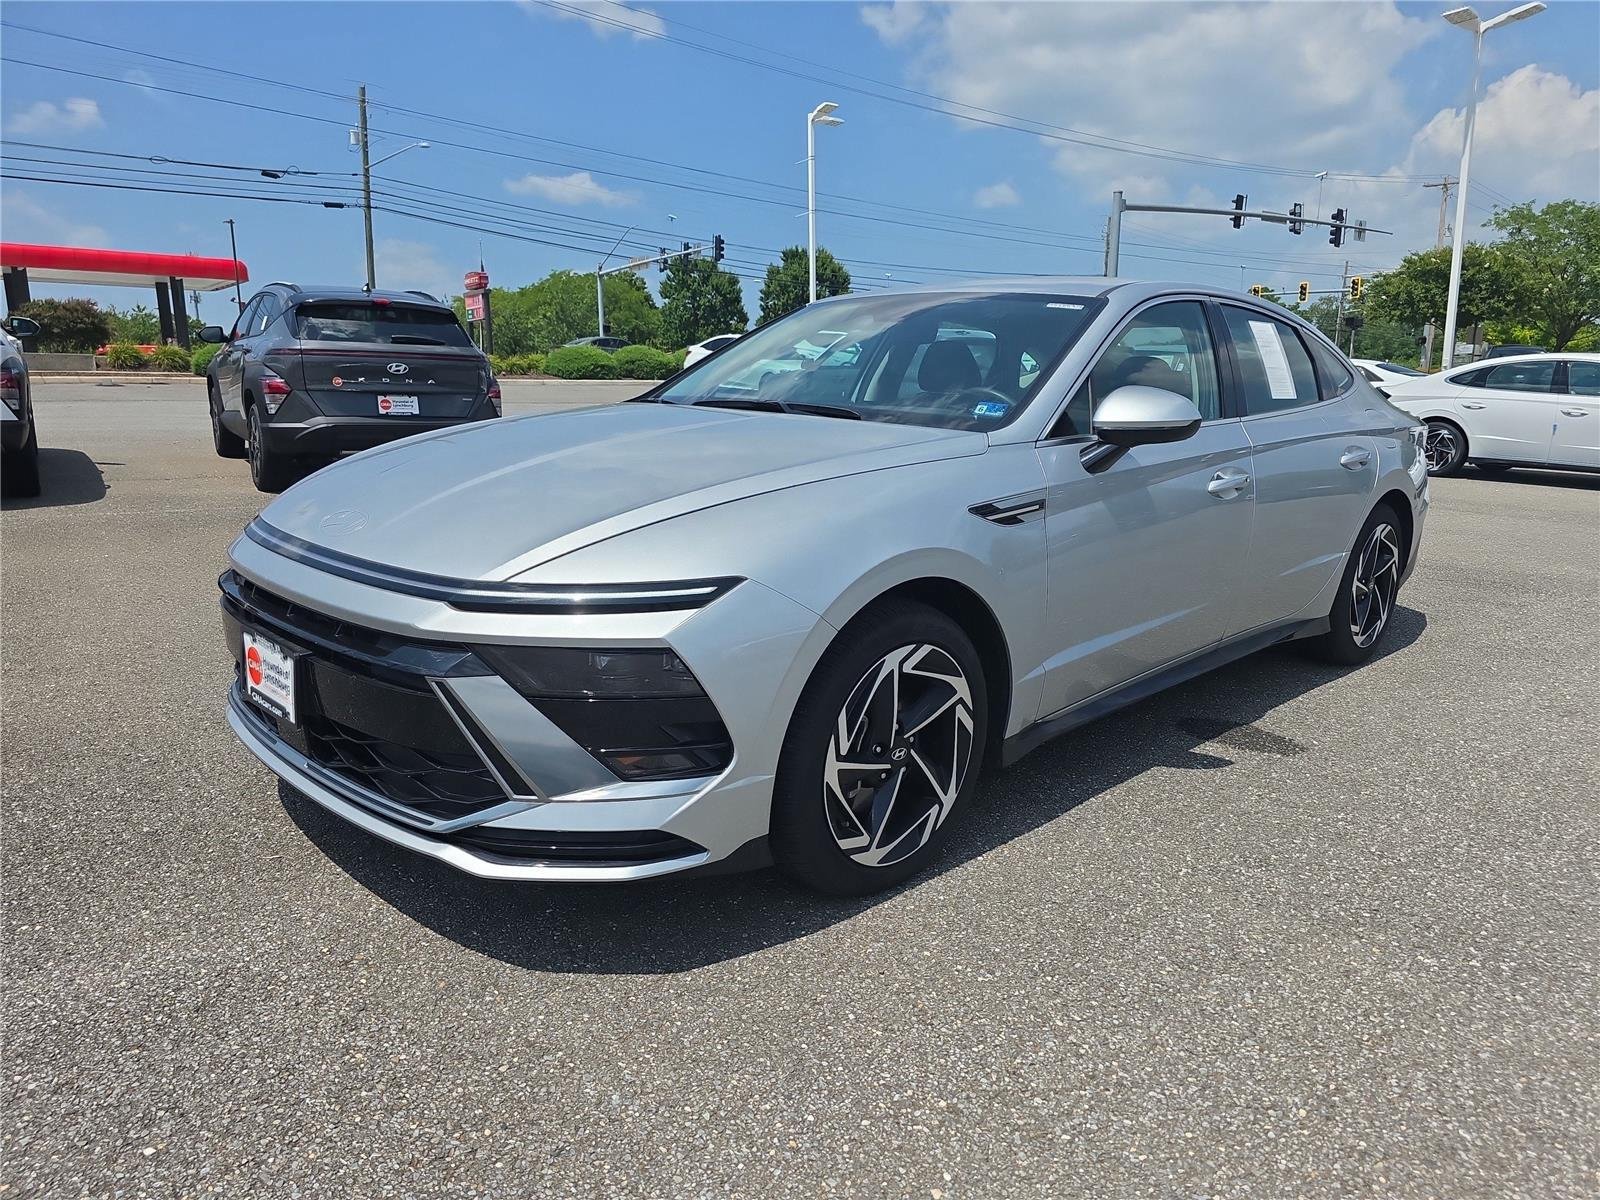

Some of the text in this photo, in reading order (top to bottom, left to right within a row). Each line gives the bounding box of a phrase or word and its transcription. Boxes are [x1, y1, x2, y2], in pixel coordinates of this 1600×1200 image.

[263, 656, 284, 678] Hyundai
[264, 670, 290, 696] Lynchburg
[251, 691, 283, 718] CMAcars.com
